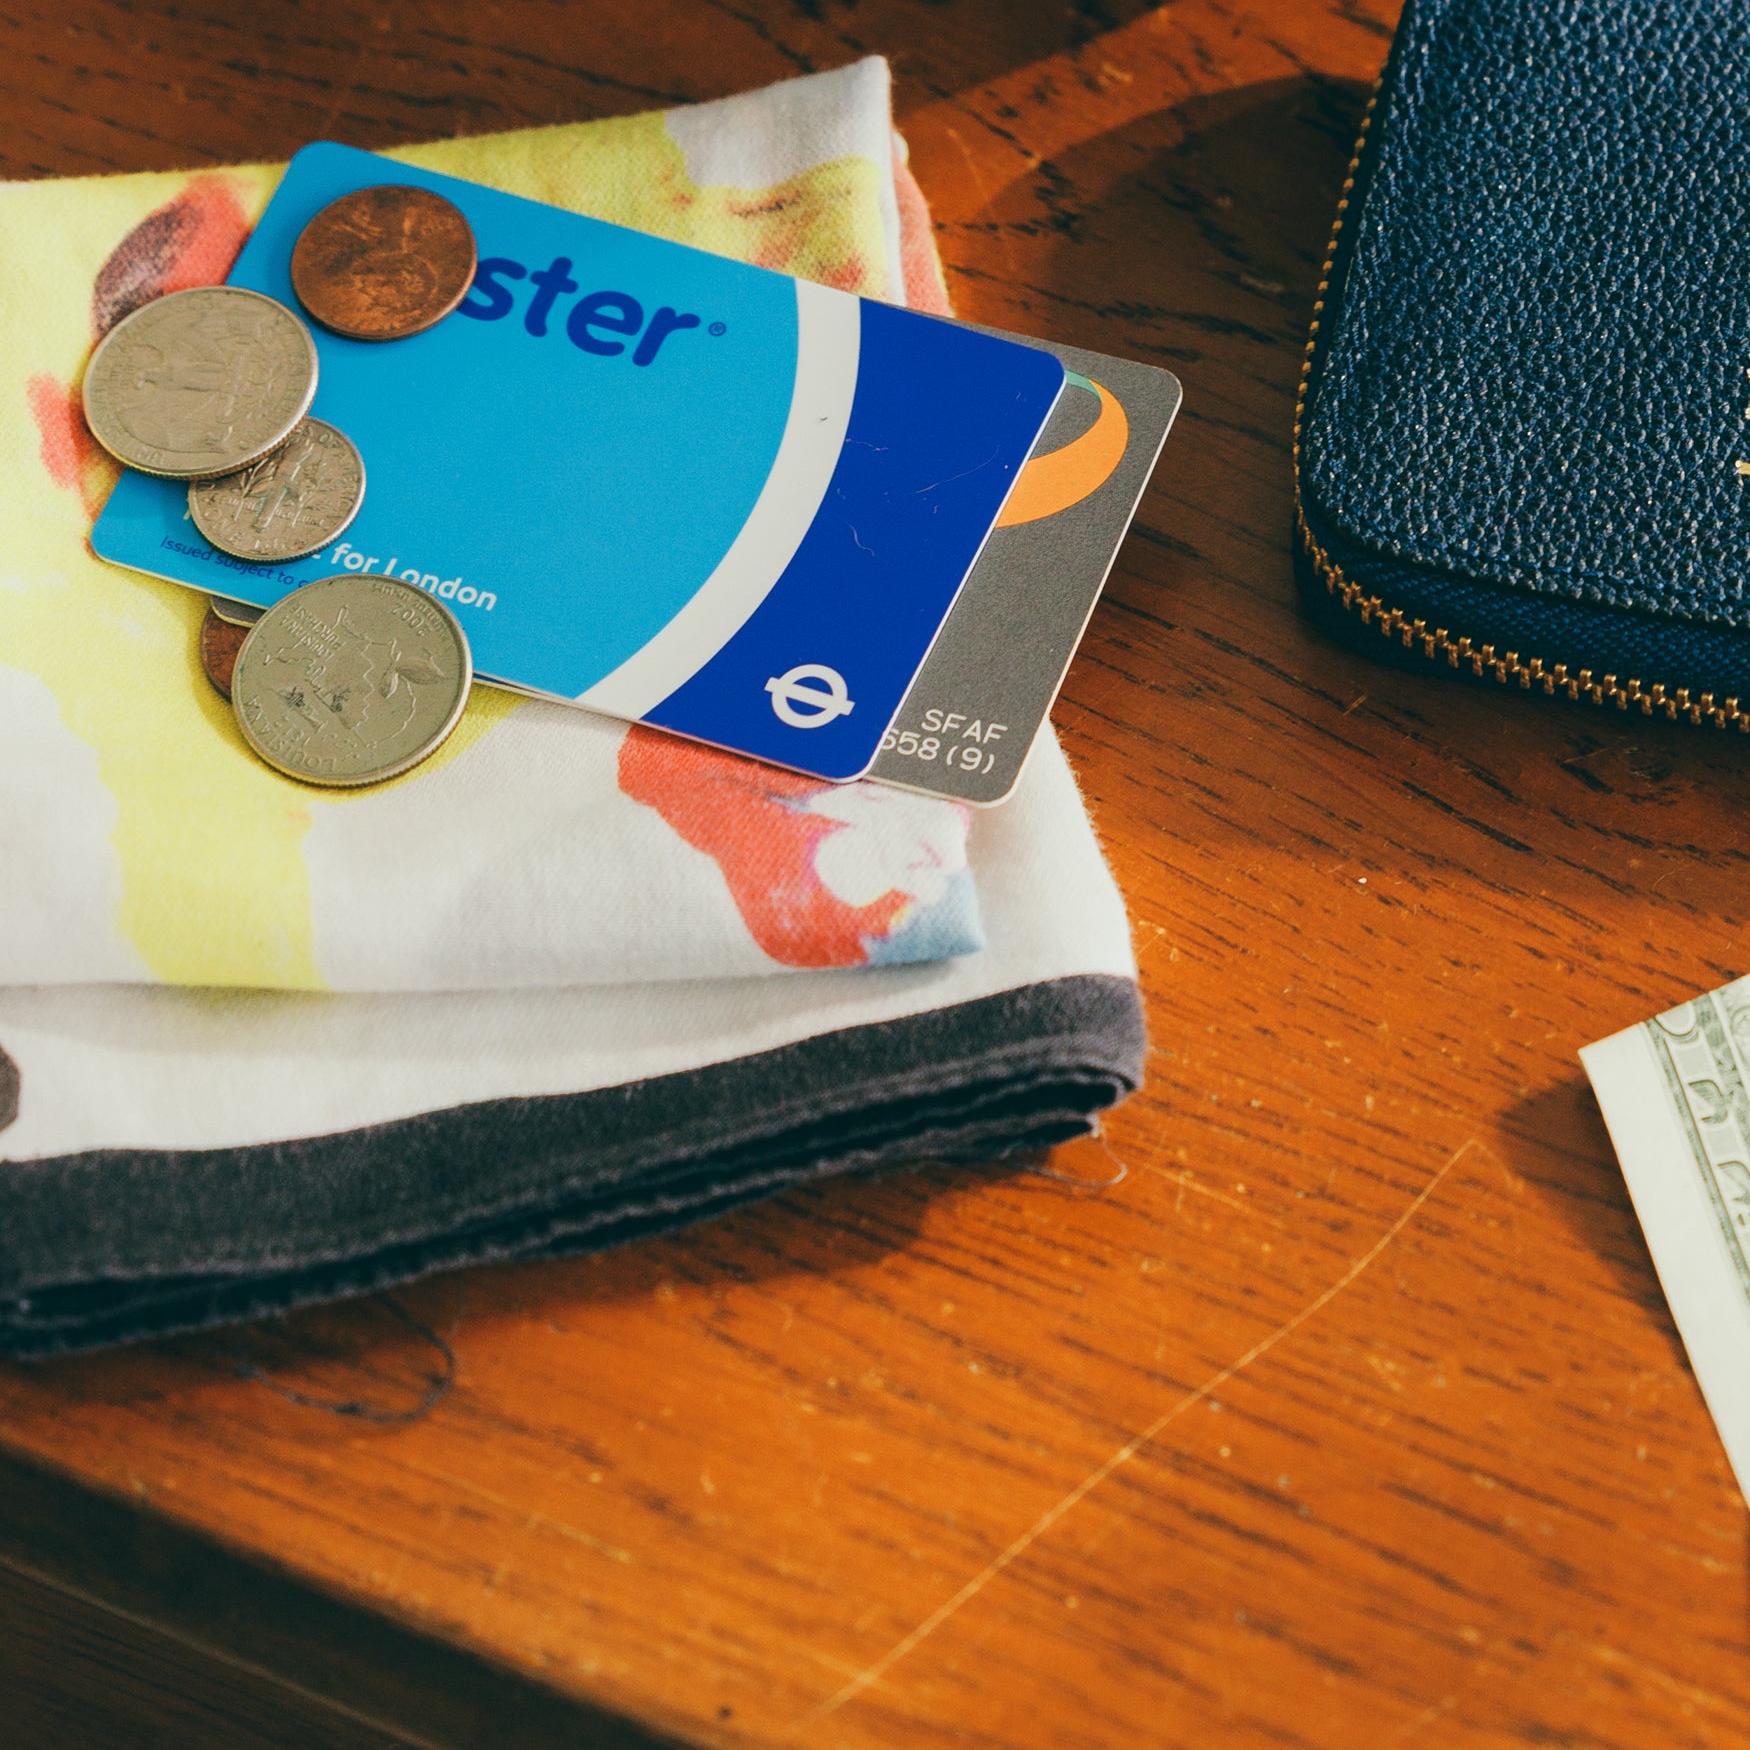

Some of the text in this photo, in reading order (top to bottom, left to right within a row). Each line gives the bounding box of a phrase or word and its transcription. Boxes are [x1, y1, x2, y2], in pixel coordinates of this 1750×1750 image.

[160, 535, 215, 562] Issued
[276, 571, 296, 587] to
[331, 543, 498, 611] for London
[921, 709, 1008, 744] SFAF
